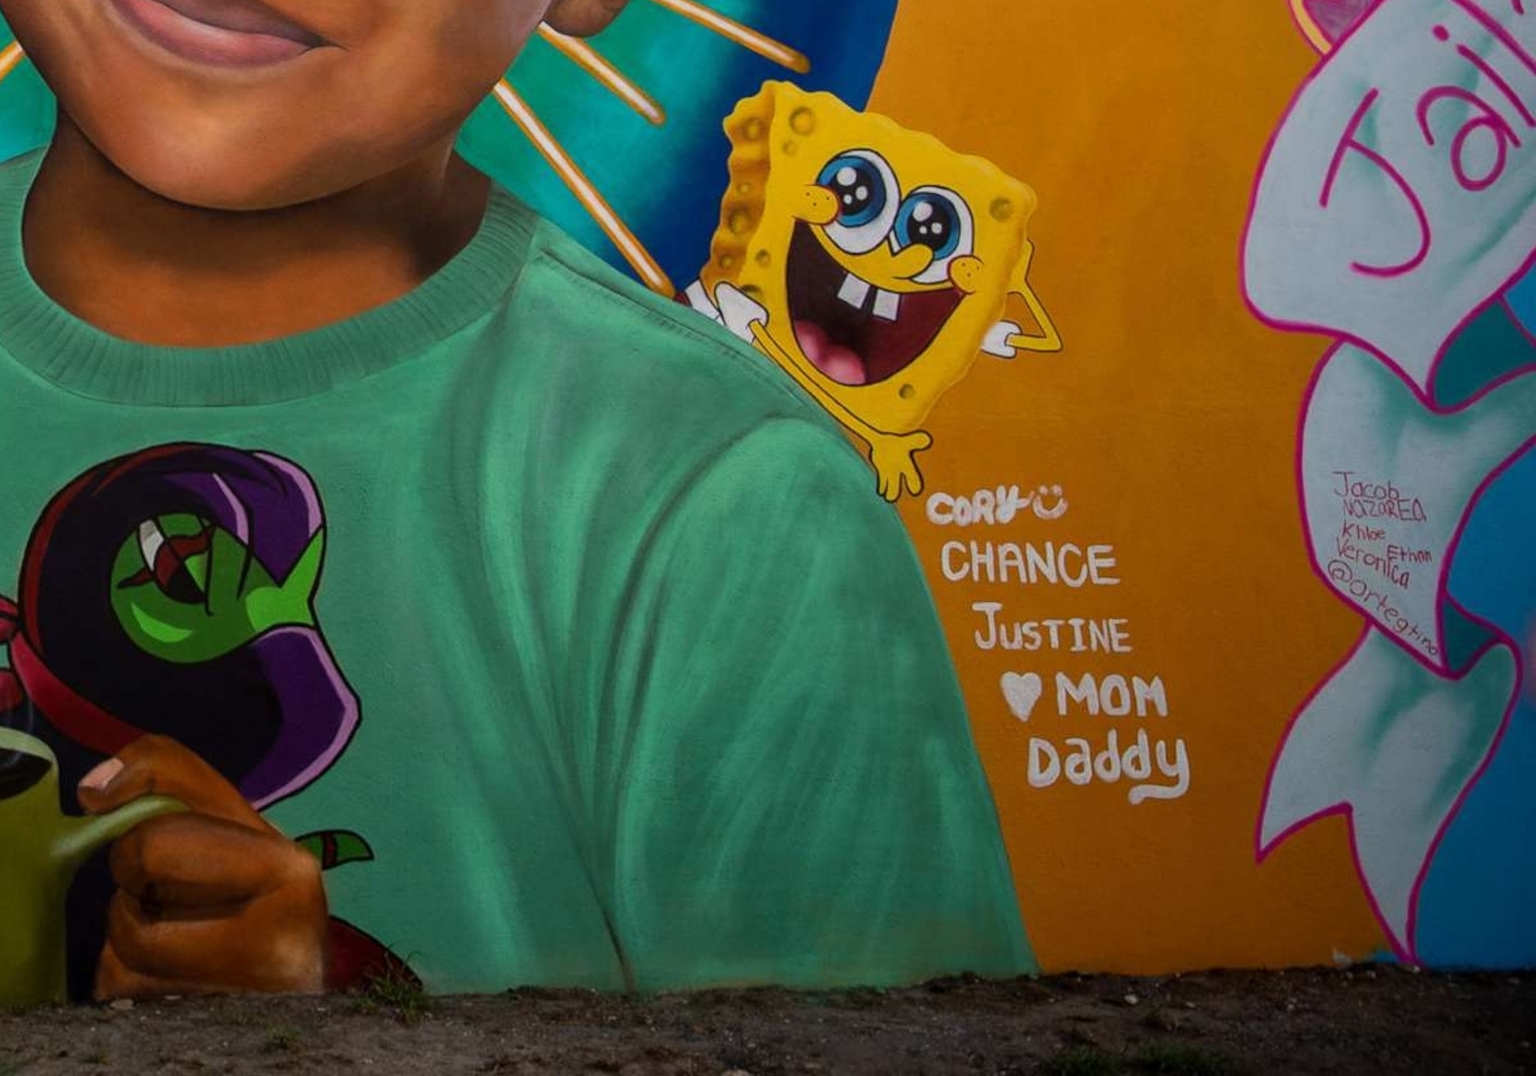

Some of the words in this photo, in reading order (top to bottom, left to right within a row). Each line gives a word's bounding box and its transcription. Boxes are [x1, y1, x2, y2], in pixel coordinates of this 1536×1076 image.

[1332, 471, 1400, 501] Jacob
[1342, 520, 1386, 541] Khloe
[940, 540, 1121, 588] CHANCE
[1386, 544, 1432, 564] Ethan
[971, 601, 1134, 653] JUSTINE
[1055, 671, 1169, 717] MOM
[1027, 727, 1191, 805] Daddy
